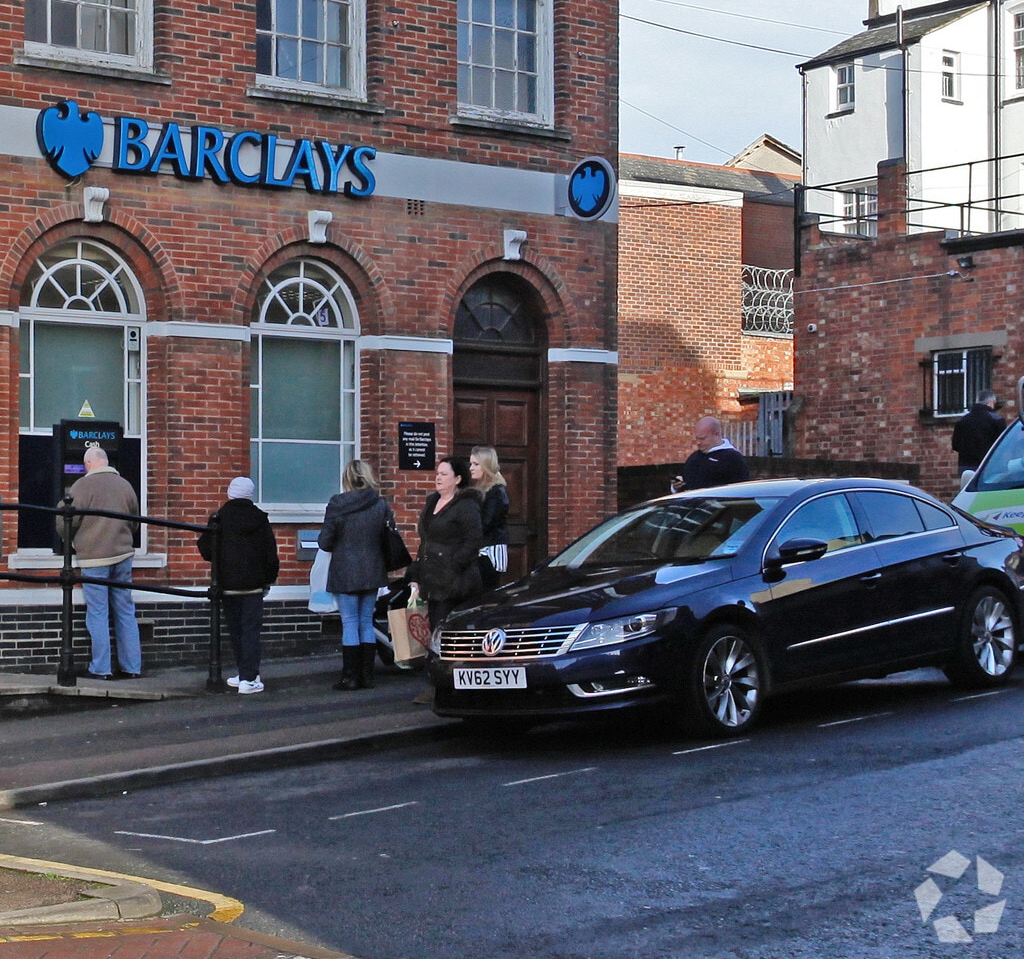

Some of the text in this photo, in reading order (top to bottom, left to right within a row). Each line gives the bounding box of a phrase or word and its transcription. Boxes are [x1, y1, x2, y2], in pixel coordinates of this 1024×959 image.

[112, 116, 377, 198] BARCLAYS
[78, 431, 116, 439] BARCLAYS
[459, 669, 520, 685] KV62 SYY
